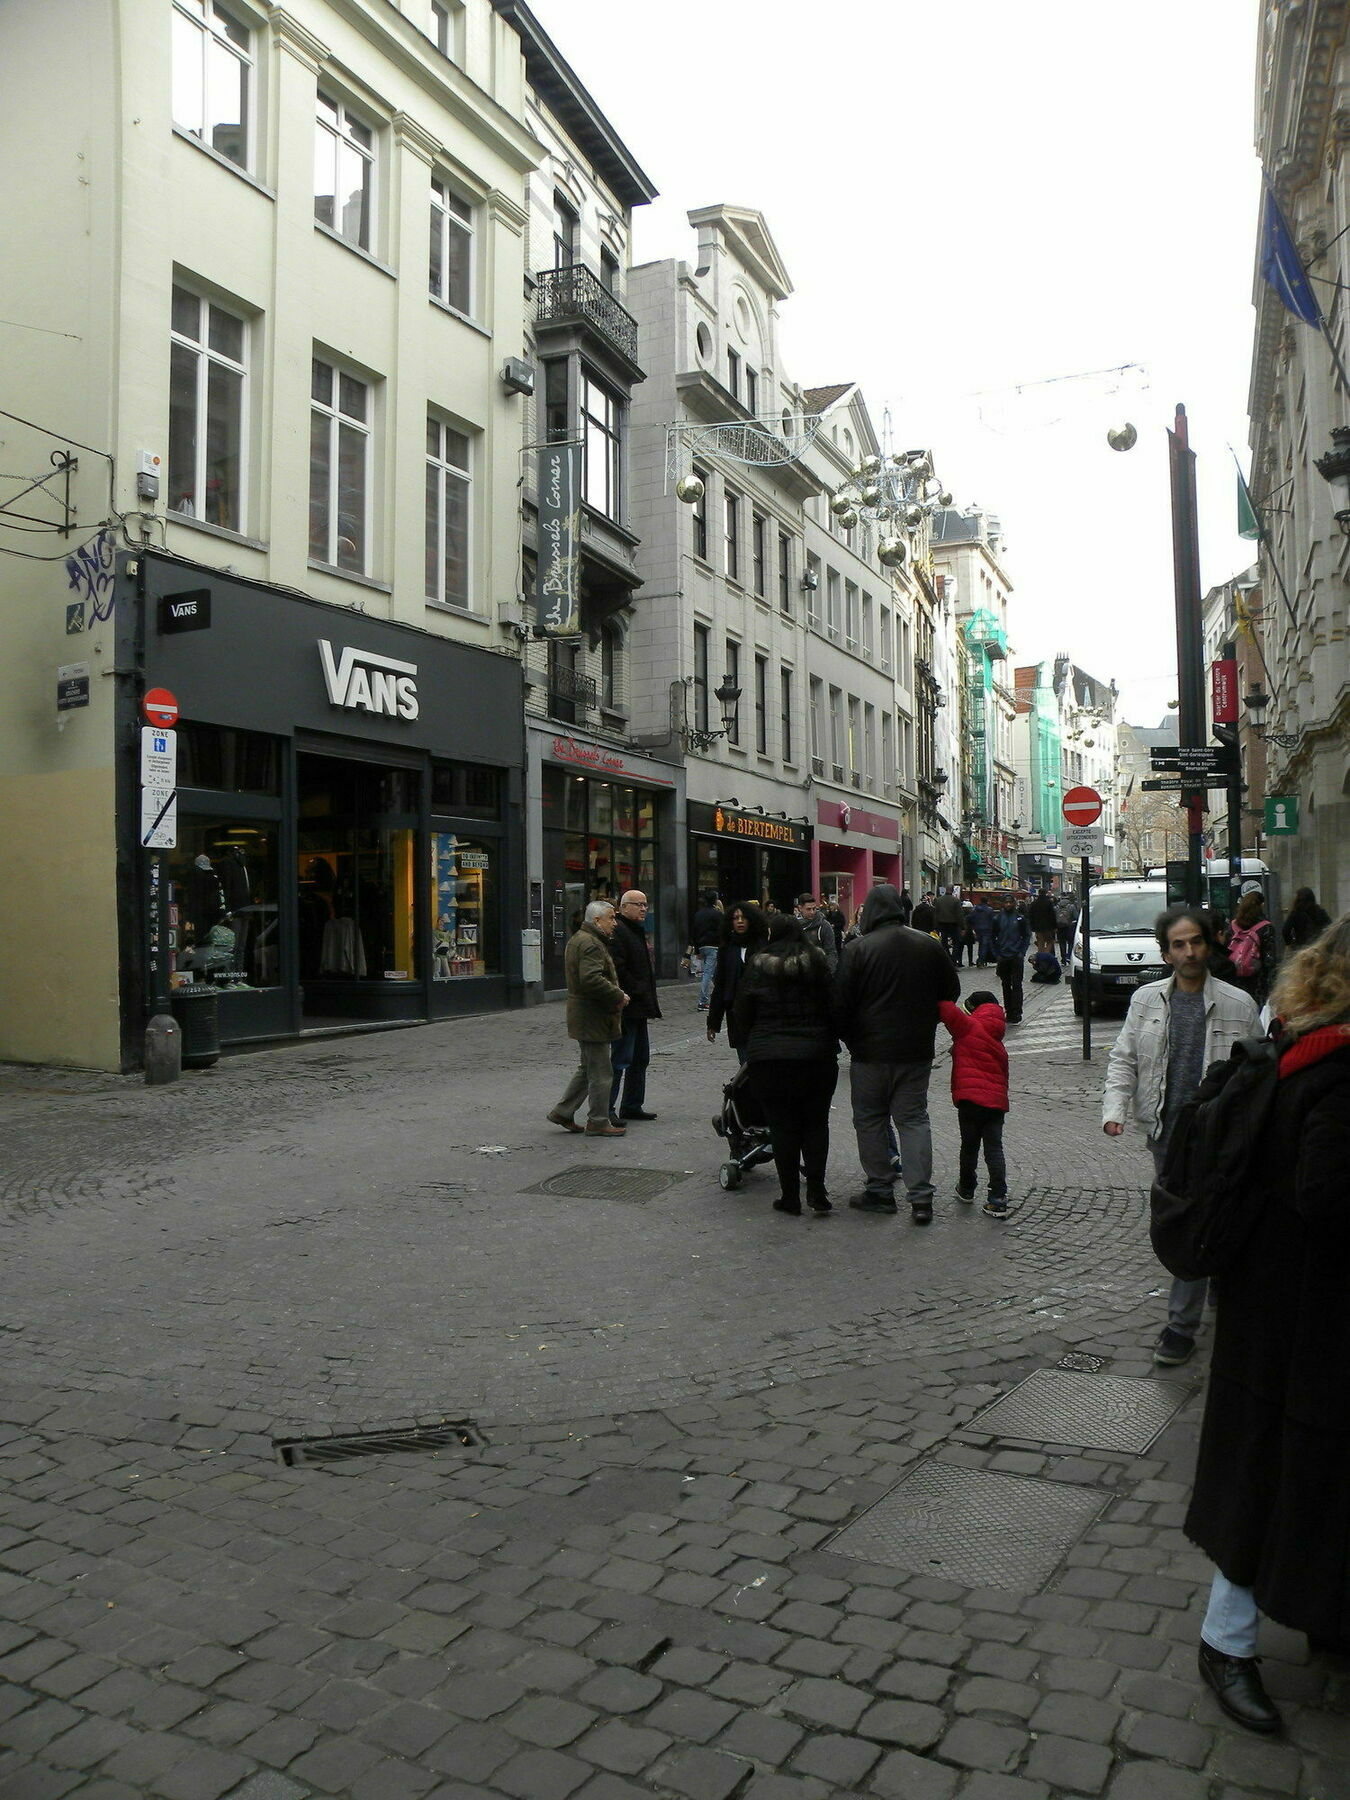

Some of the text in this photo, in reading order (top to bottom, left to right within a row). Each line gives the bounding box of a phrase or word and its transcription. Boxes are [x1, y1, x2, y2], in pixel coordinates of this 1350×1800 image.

[543, 455, 562, 631] the Brussels Corner
[171, 601, 197, 617] VANS
[317, 638, 420, 721] VANS
[152, 729, 169, 738] ZONE
[152, 789, 169, 797] ZONE
[726, 815, 795, 843] de BIERTEMPEL
[213, 971, 248, 979] www.vans.eu
